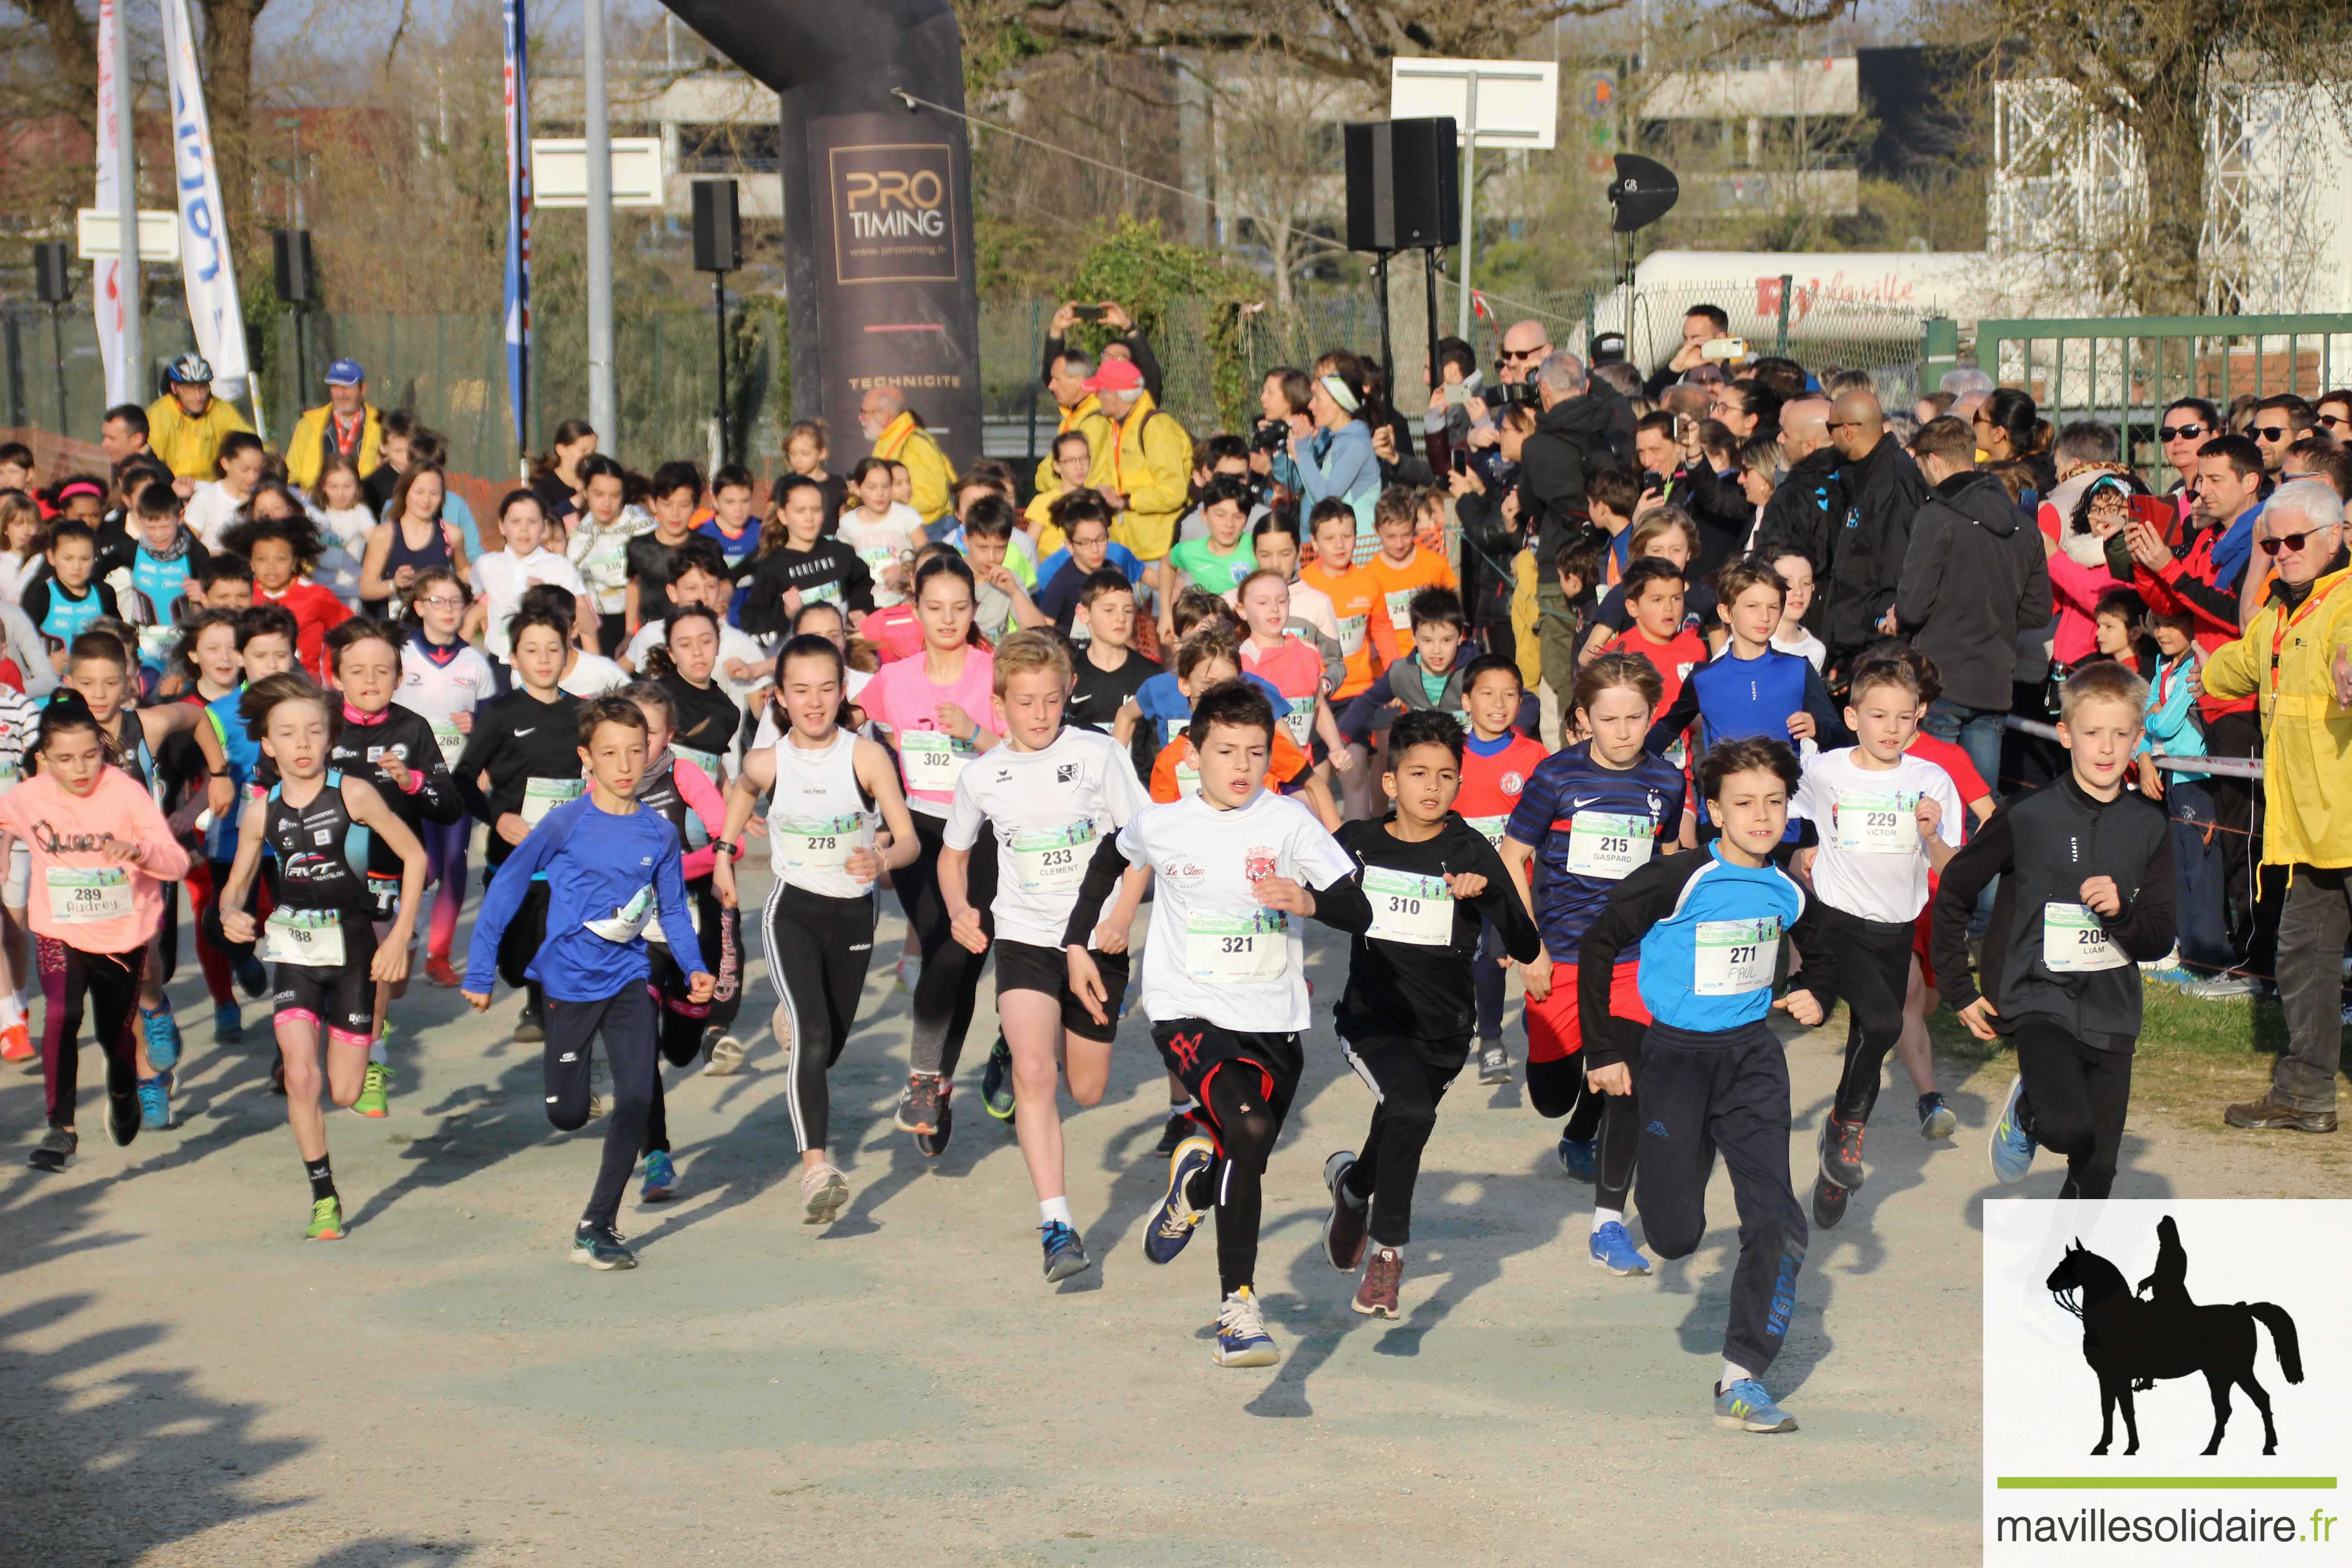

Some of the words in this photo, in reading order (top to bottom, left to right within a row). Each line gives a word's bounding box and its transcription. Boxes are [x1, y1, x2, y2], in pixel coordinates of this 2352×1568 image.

[846, 170, 942, 210] PRO
[849, 210, 945, 239] TIMING
[439, 736, 460, 746] 268
[923, 753, 950, 766] 302
[1867, 813, 1896, 827] 229
[808, 837, 836, 850] 278
[1600, 837, 1627, 853] 215
[2070, 837, 2078, 862] KIPSTA
[1042, 849, 1072, 866] 233
[1593, 853, 1632, 863] GASPARD
[312, 871, 344, 882] TRIATHLON
[1039, 864, 1078, 876] CLEMENT
[1165, 864, 1177, 876] Le
[74, 888, 102, 900] 289
[67, 900, 118, 913] Audrey
[1389, 897, 1420, 915] 310
[2078, 930, 2109, 944] 209
[1221, 936, 1253, 953] 321
[2083, 946, 2105, 954] LIAM
[1730, 946, 1756, 964] 271
[1728, 966, 1756, 980] PAUL
